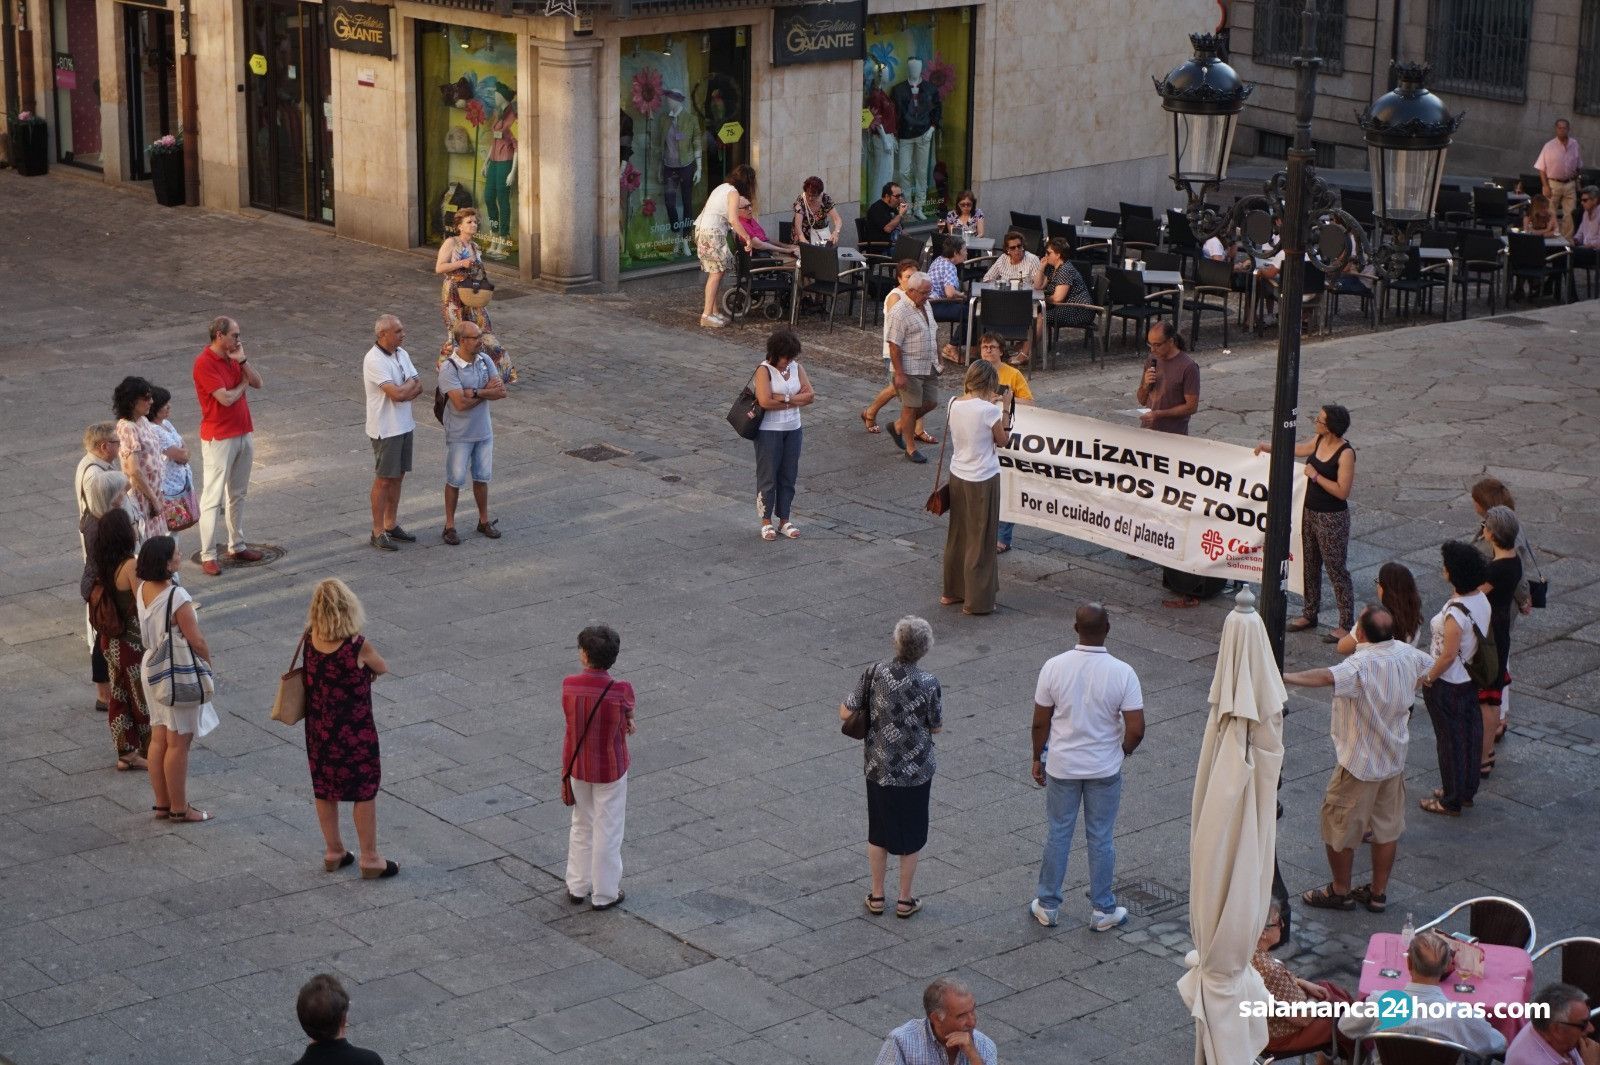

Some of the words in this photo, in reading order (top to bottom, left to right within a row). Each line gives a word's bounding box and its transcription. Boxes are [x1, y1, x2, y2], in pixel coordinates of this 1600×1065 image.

[333, 17, 383, 44] GALANTE
[786, 29, 854, 52] GALANTE
[650, 221, 672, 235] shop
[673, 217, 695, 230] onlin
[997, 432, 1170, 475] MOVILÍZATE
[1178, 460, 1232, 493] POR
[1237, 478, 1269, 502] LO
[997, 455, 1155, 499] DERECHOS
[1160, 485, 1197, 512] DE
[1202, 497, 1268, 533] TODO
[1021, 491, 1043, 512] Por
[1046, 499, 1058, 515] el
[1061, 503, 1111, 530] cuidado
[1114, 515, 1133, 536] del
[1134, 522, 1175, 551] planeta
[1226, 553, 1263, 563] Diocesan
